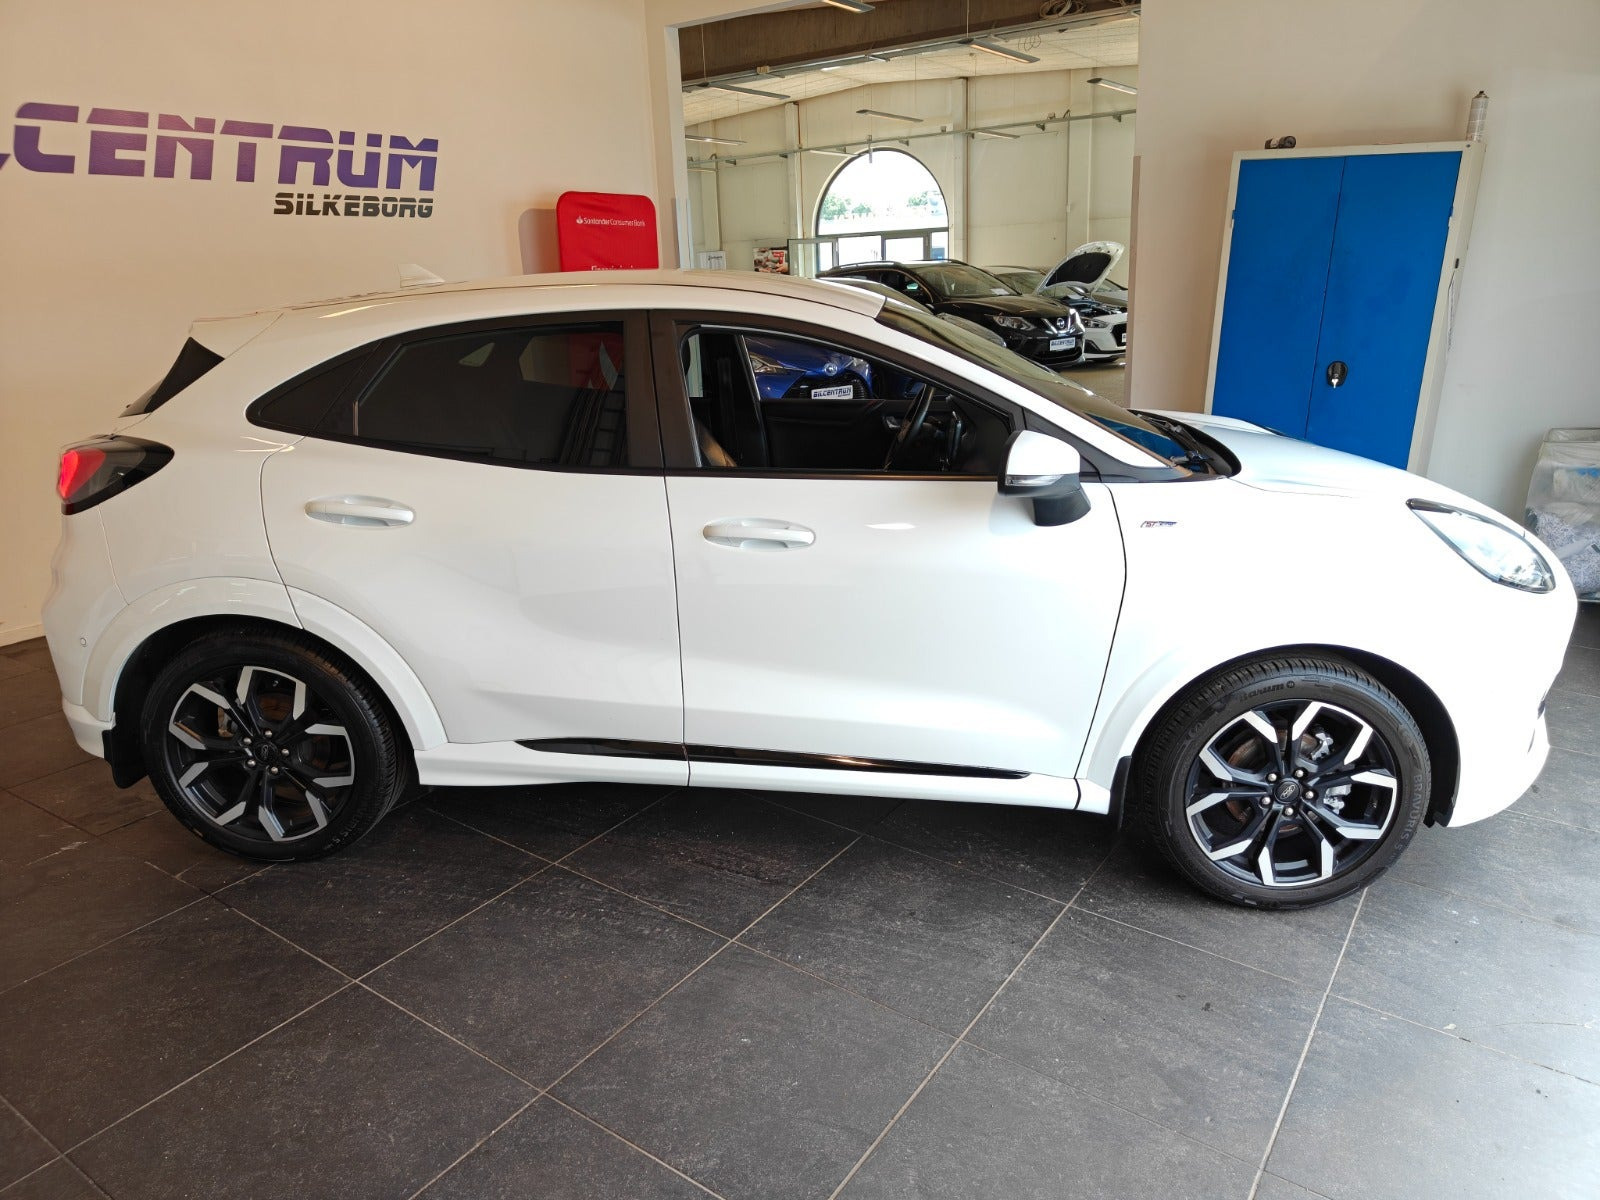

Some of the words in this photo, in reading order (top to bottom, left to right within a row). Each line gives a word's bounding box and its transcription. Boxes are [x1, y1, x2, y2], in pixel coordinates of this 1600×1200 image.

[0, 102, 438, 191] CENTRUM
[274, 192, 434, 218] SILKEBORG
[584, 217, 609, 225] Santander
[634, 219, 645, 227] Bank
[1401, 774, 1423, 840] BRAVURIS
